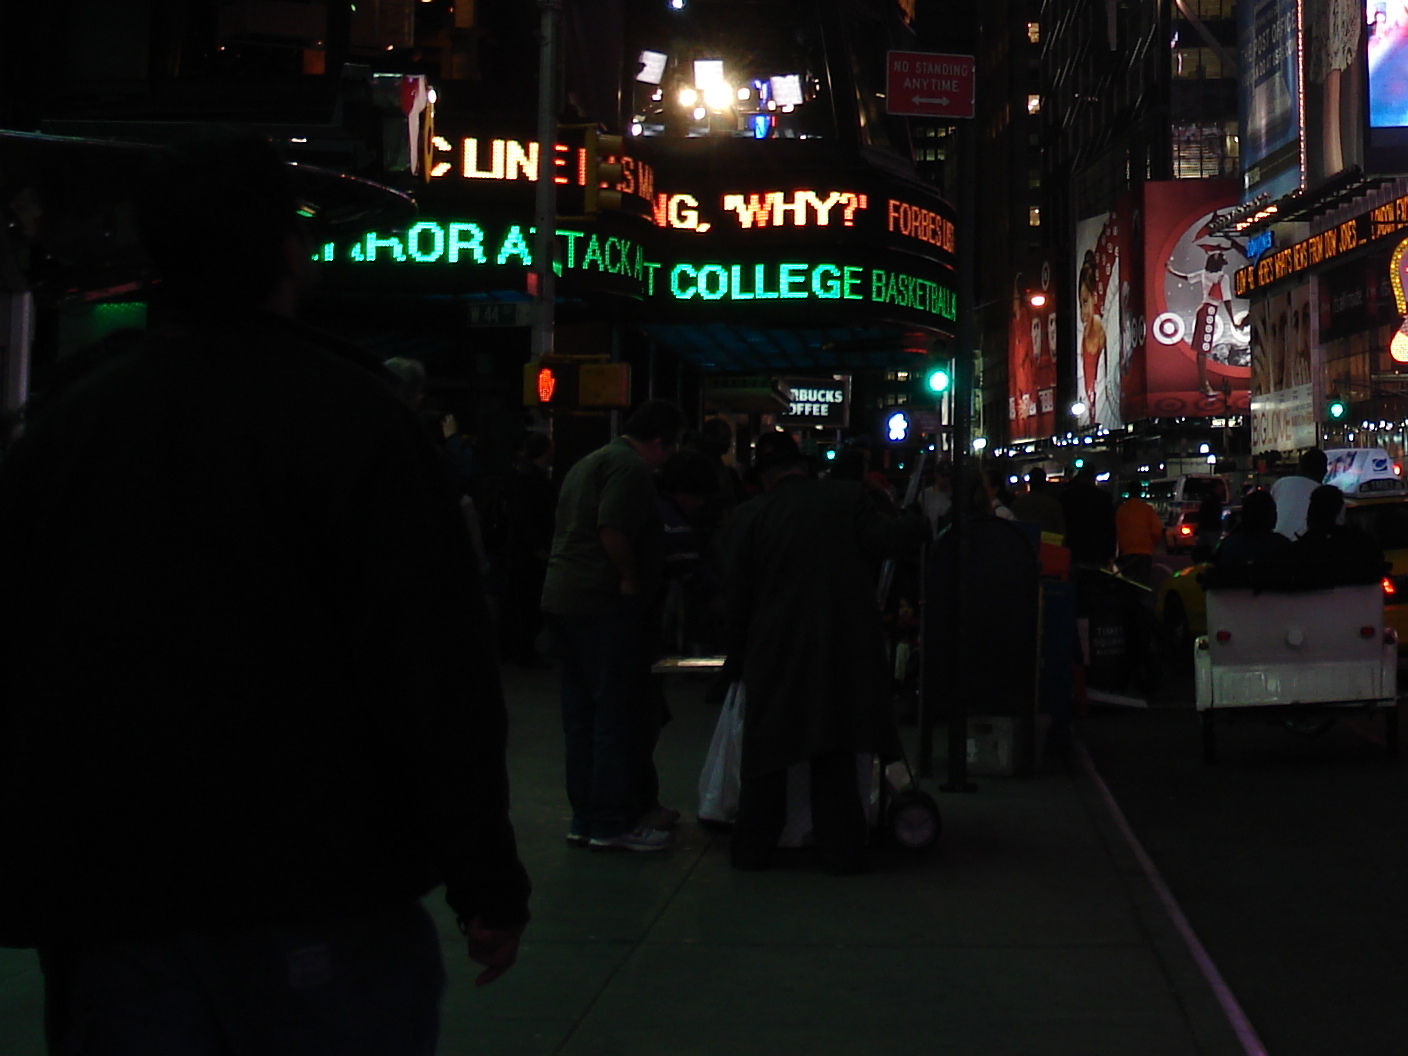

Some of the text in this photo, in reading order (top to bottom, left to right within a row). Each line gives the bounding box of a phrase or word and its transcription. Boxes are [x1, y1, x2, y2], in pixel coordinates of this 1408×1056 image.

[894, 61, 968, 76] NO STANDING
[903, 78, 960, 93] ANYTIME
[888, 198, 942, 251] FORBES
[671, 263, 863, 300] COLLEGE
[782, 403, 829, 417] OFFEE
